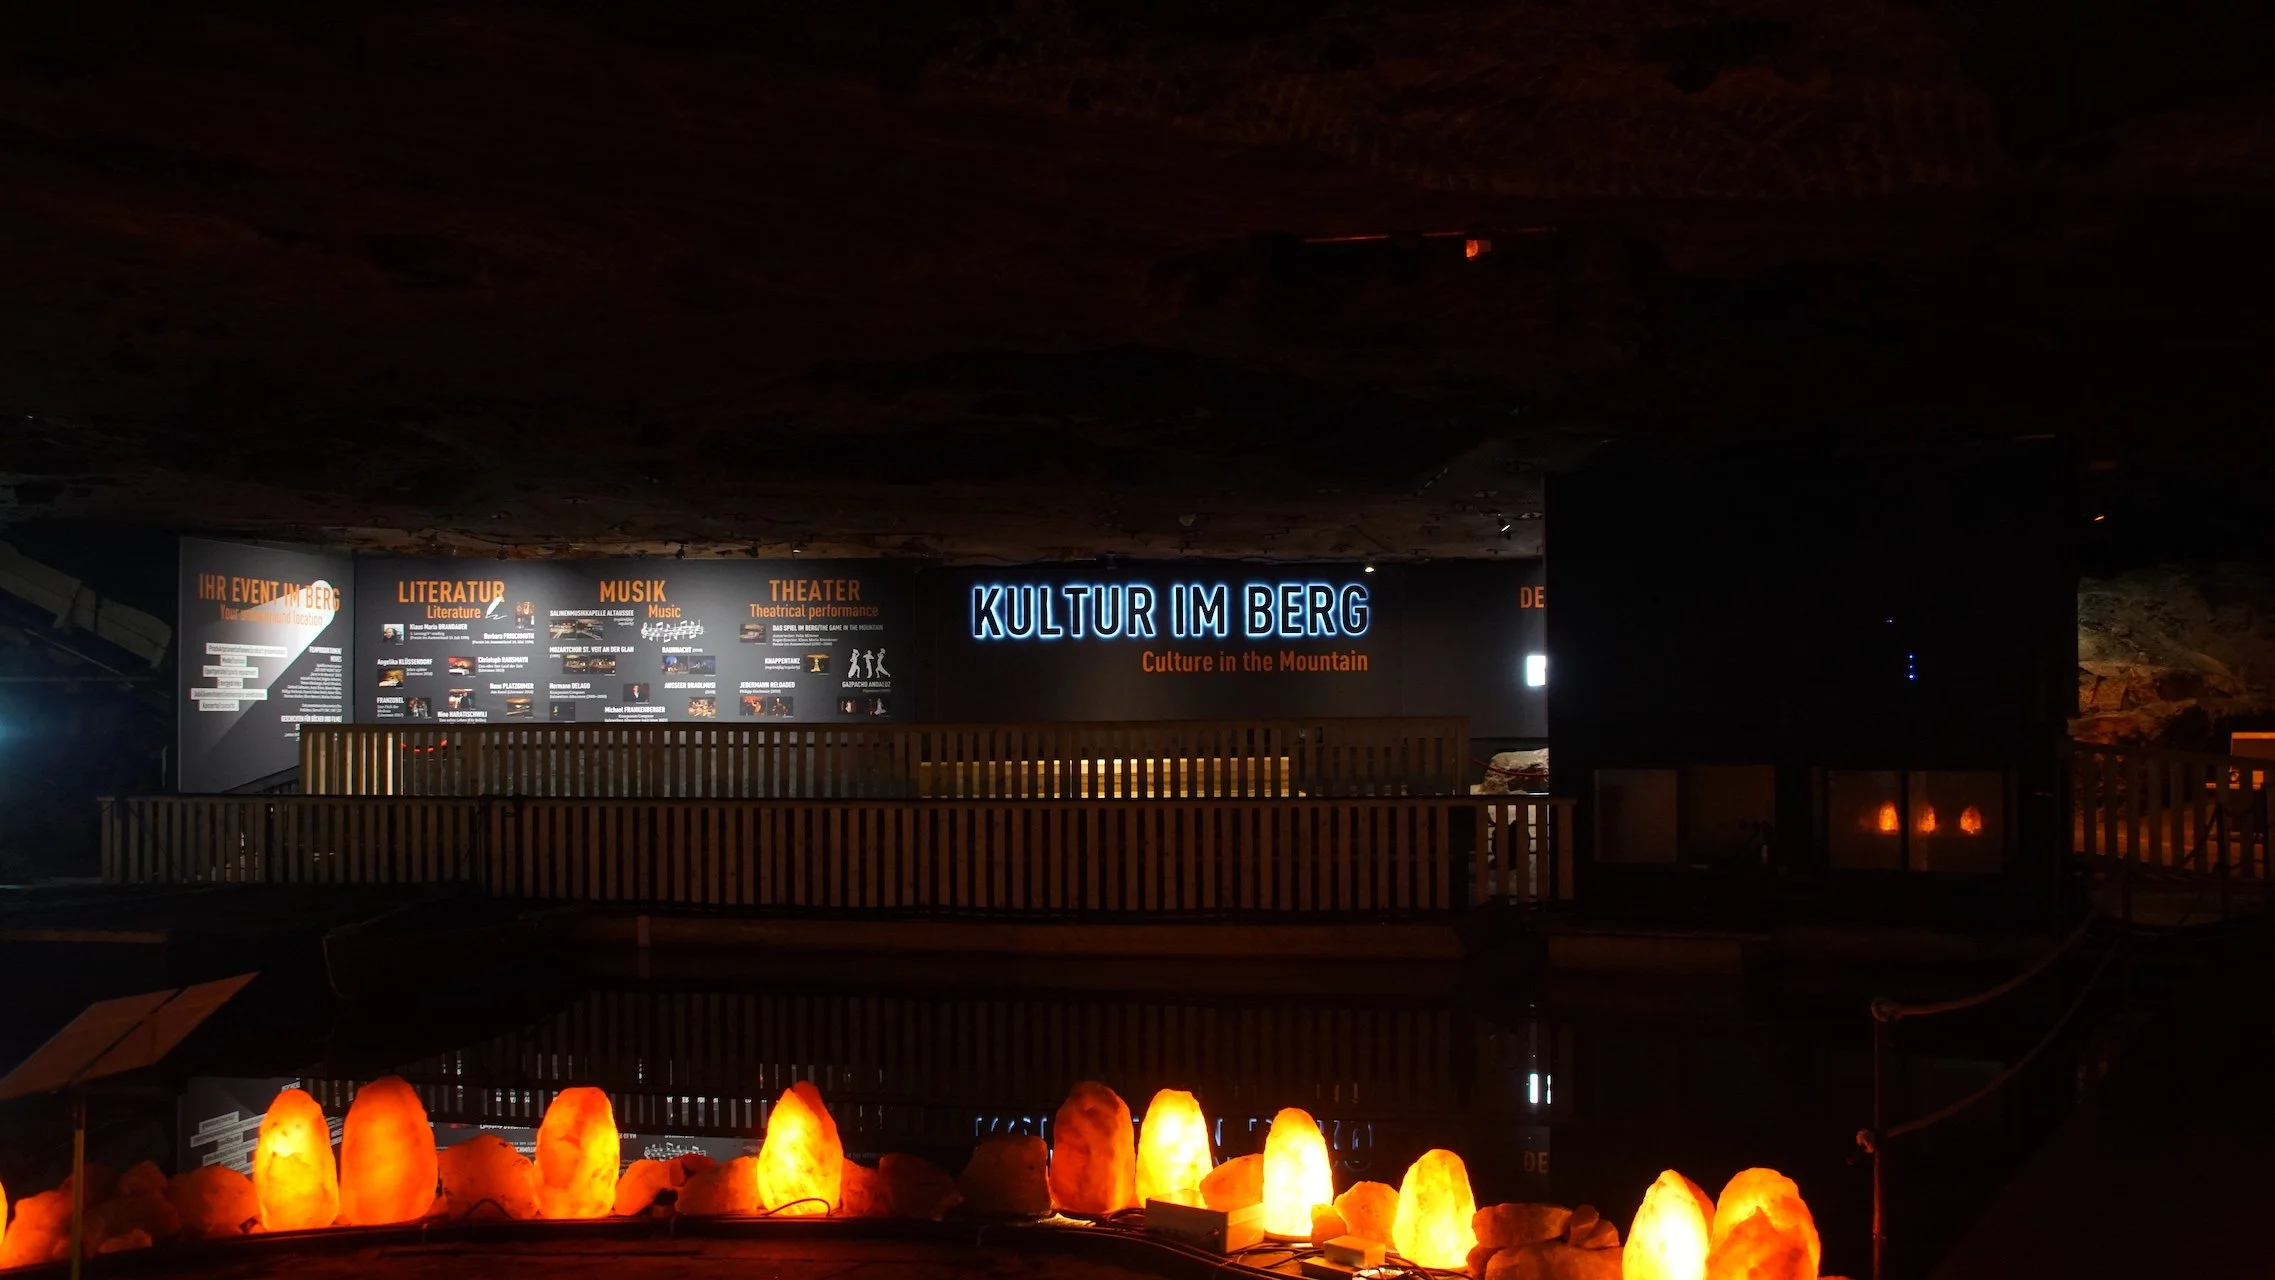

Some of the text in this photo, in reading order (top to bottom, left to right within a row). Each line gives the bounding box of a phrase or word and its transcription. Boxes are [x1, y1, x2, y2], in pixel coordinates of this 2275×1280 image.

[199, 573, 341, 612] IHR EVENT IM BERG
[398, 580, 506, 603] LITERATUR
[599, 580, 666, 603] MUSIK
[769, 580, 861, 602] THEATER
[220, 604, 238, 620] Your
[293, 610, 323, 626] location
[427, 605, 481, 619] Literature
[649, 604, 681, 618] Music
[750, 604, 879, 620] Theatrical performance
[972, 585, 1370, 637] KULTUR IM BERG
[377, 659, 398, 667] Angelika
[478, 656, 501, 664] Christoph
[1142, 650, 1368, 672] Culture in the Mountain
